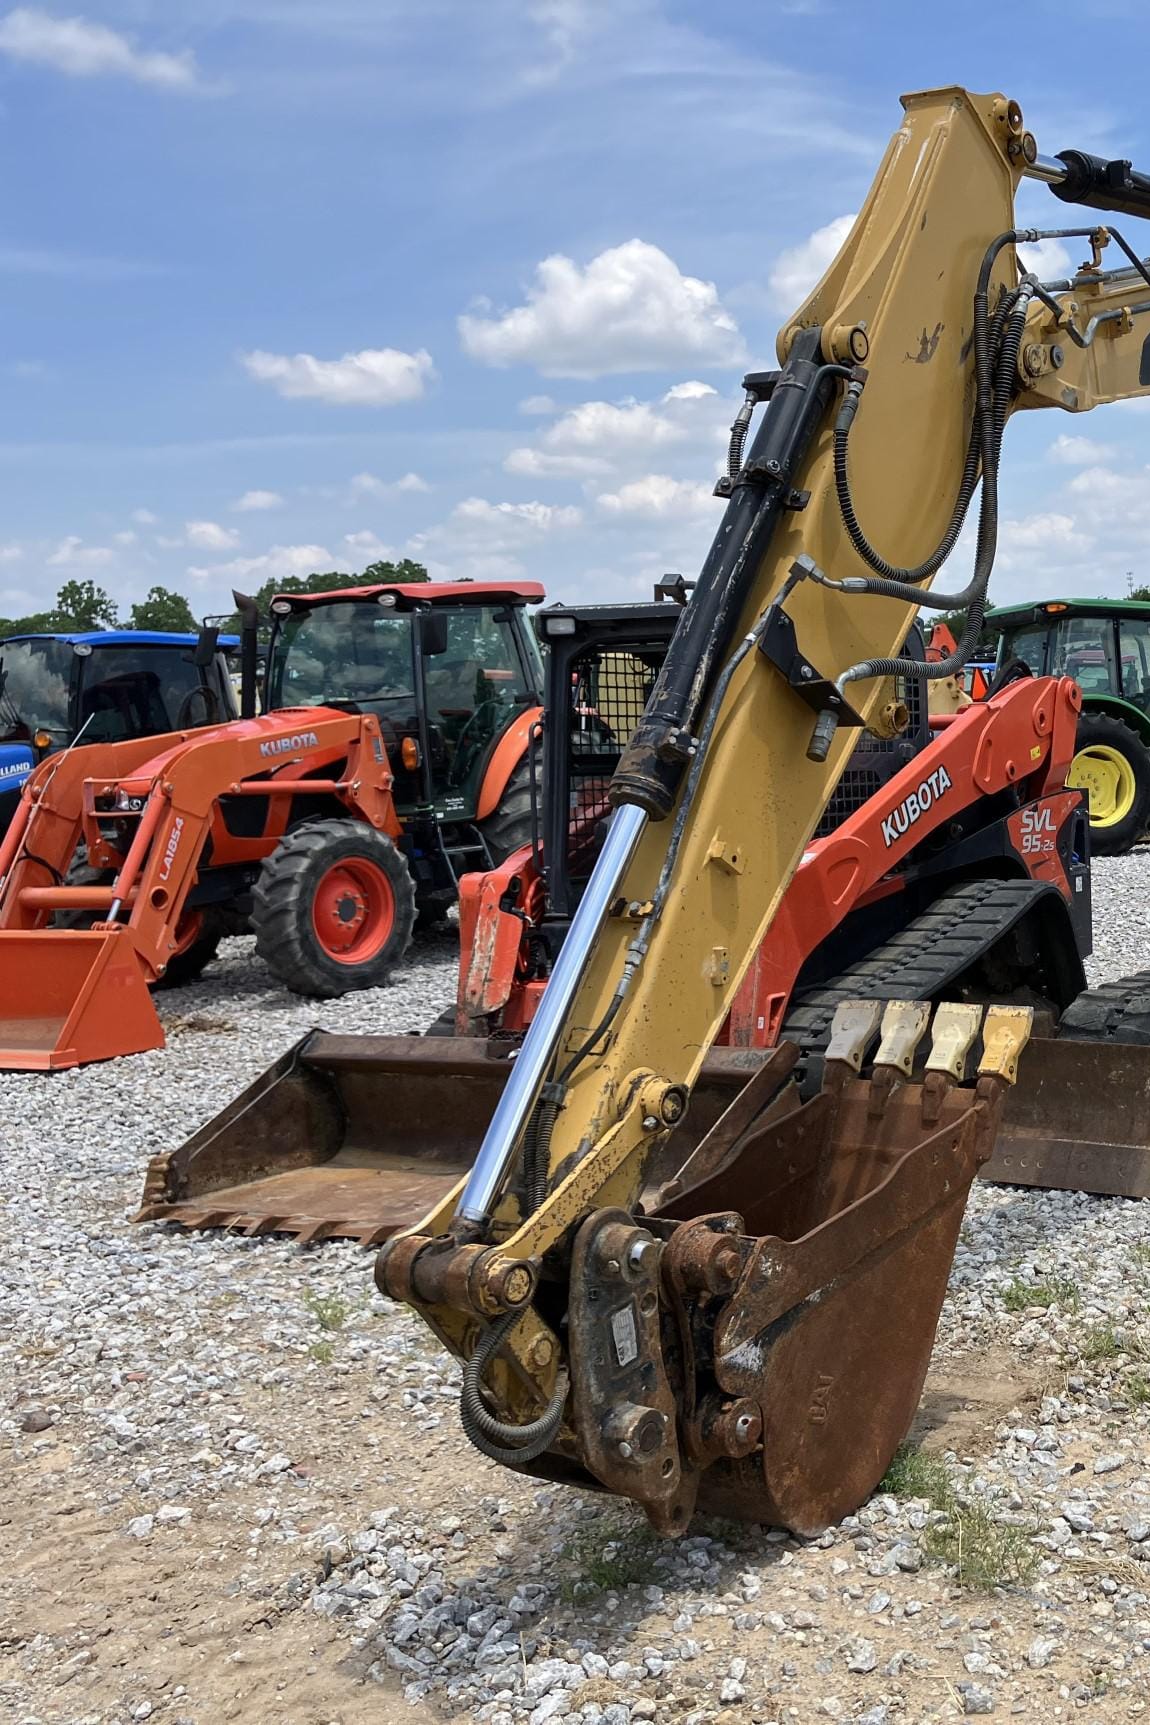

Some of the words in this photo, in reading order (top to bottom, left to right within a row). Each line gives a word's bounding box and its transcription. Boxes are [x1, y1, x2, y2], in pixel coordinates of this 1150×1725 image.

[259, 731, 319, 757] KUBOTA
[880, 764, 953, 849] KUBOTA
[1020, 808, 1057, 833] SVL
[159, 816, 184, 881] LA1854
